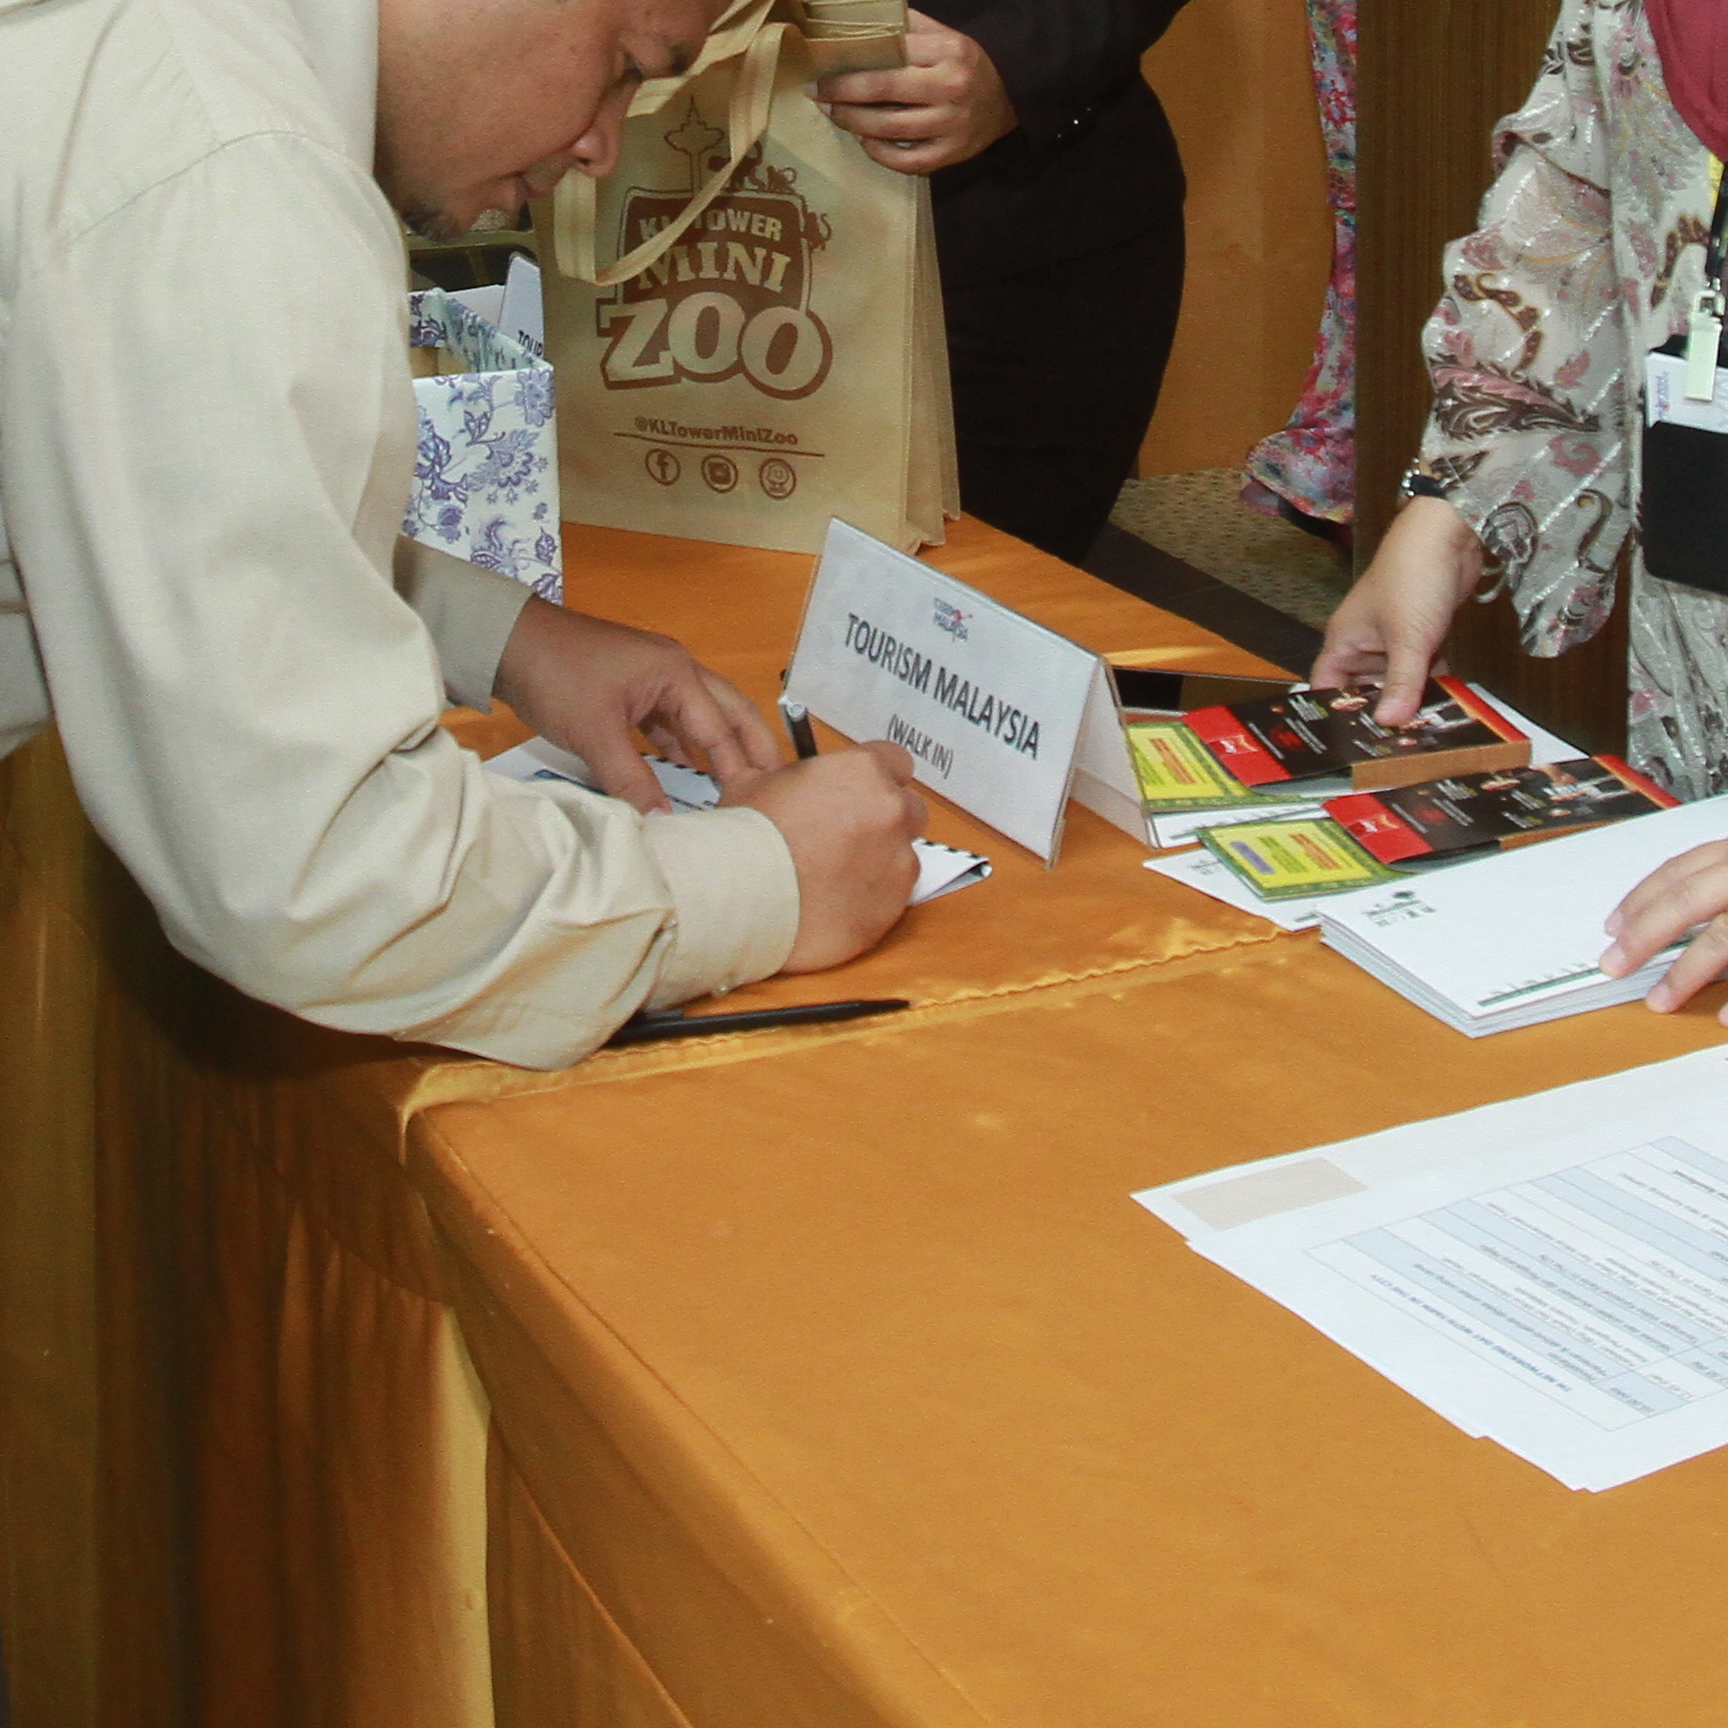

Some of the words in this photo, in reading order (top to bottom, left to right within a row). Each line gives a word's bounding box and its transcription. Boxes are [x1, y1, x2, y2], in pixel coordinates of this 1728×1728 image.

[637, 241, 791, 293] MINI
[597, 290, 833, 400] ZOO
[634, 416, 798, 447] @KLTowerMiniZoo
[844, 612, 933, 695] TOURISM
[935, 667, 1041, 761] MALAYSIA
[886, 713, 932, 761] (WALK
[931, 742, 954, 780] IN)
